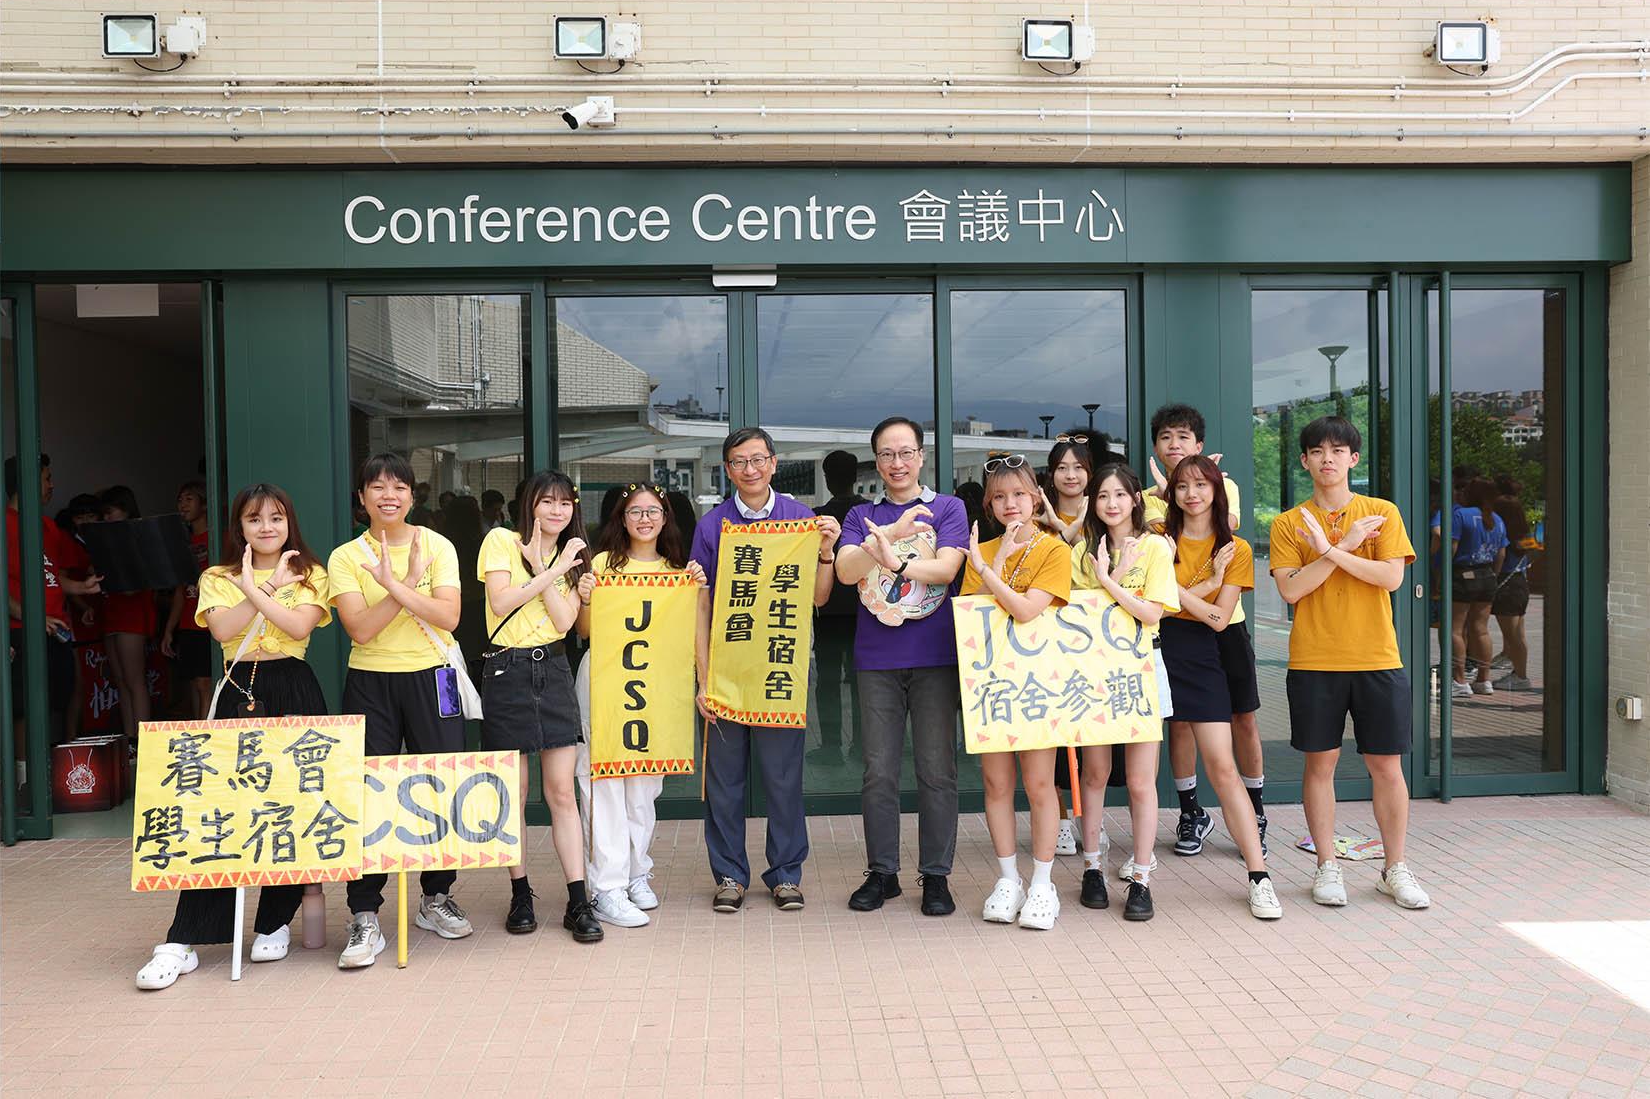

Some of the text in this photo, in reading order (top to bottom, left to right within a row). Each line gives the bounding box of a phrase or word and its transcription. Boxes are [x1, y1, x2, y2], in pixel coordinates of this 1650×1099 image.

[344, 192, 876, 244] Conference Centre
[898, 188, 1126, 243] 會議中心
[724, 543, 763, 644] 賽馬會
[765, 562, 802, 703] 學生宿舍
[972, 601, 1149, 671] JCSQ
[624, 599, 653, 754] JCSQ
[970, 667, 1152, 727] 宿舍參觀
[160, 728, 341, 797] 賽馬會
[134, 801, 360, 871] 學生宿舍
